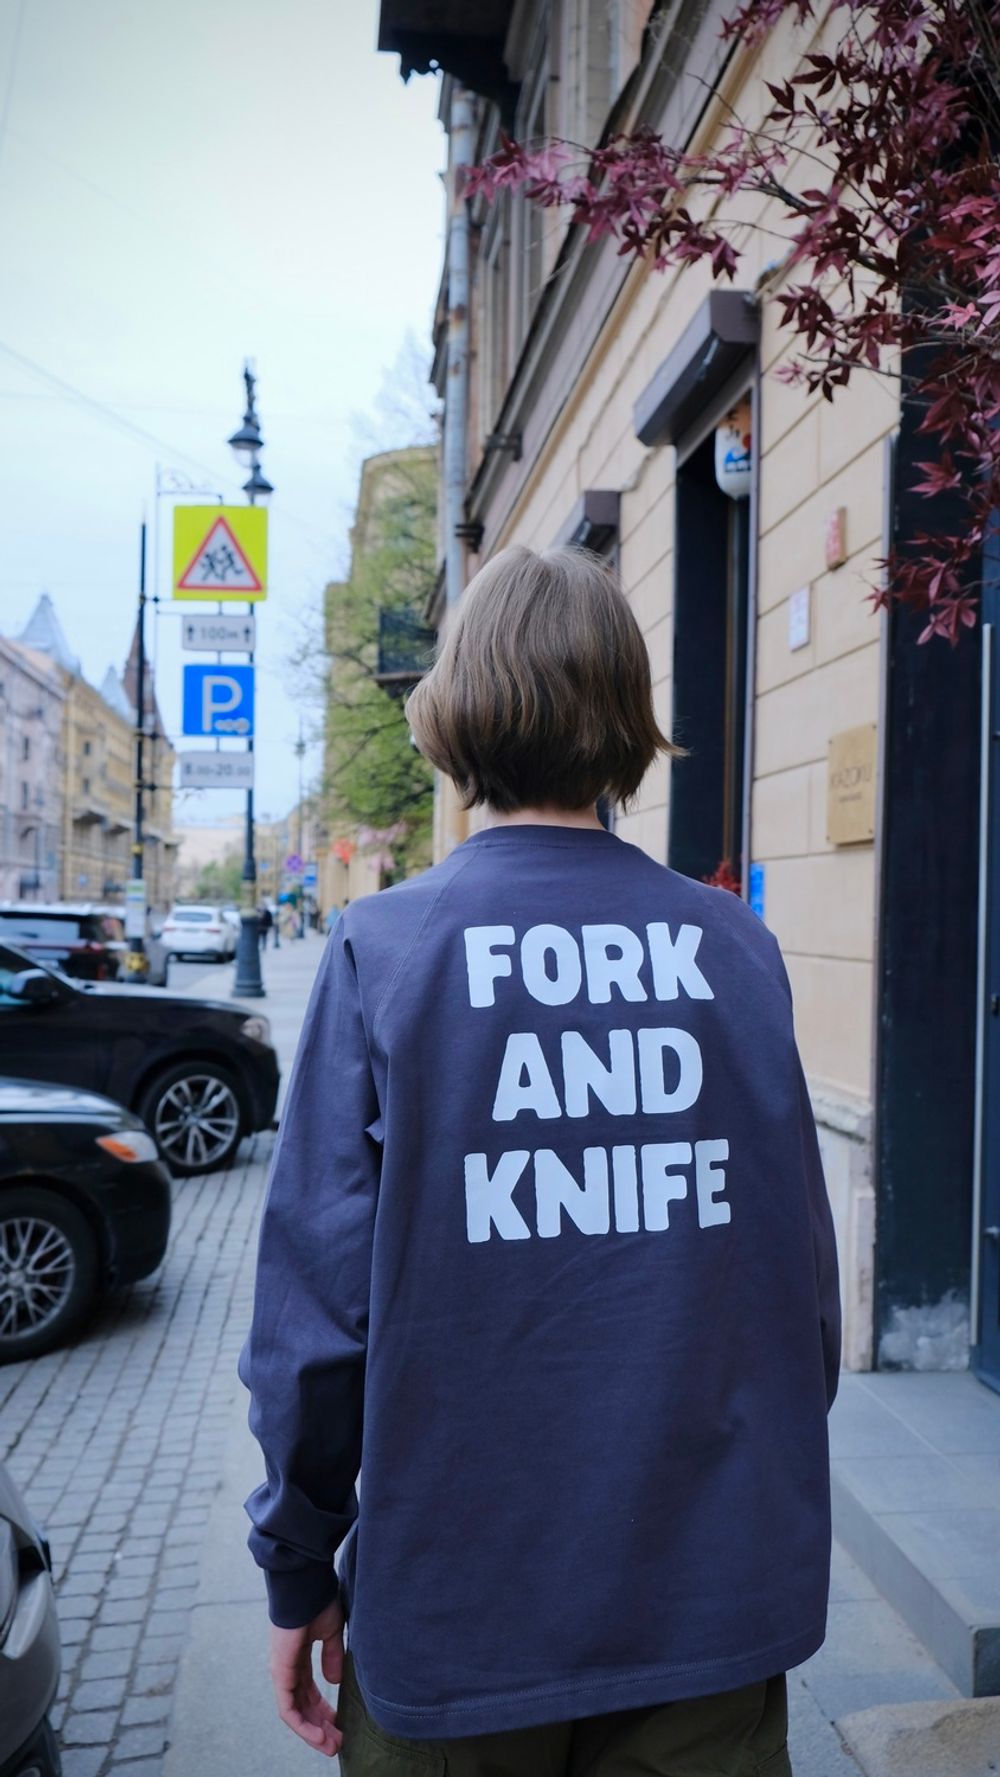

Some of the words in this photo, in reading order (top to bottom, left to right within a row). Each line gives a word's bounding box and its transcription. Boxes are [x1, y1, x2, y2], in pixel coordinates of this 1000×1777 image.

[203, 675, 243, 732] P
[464, 922, 715, 1008] FORK
[492, 1027, 703, 1122] AND
[464, 1138, 731, 1243] KNIFE
